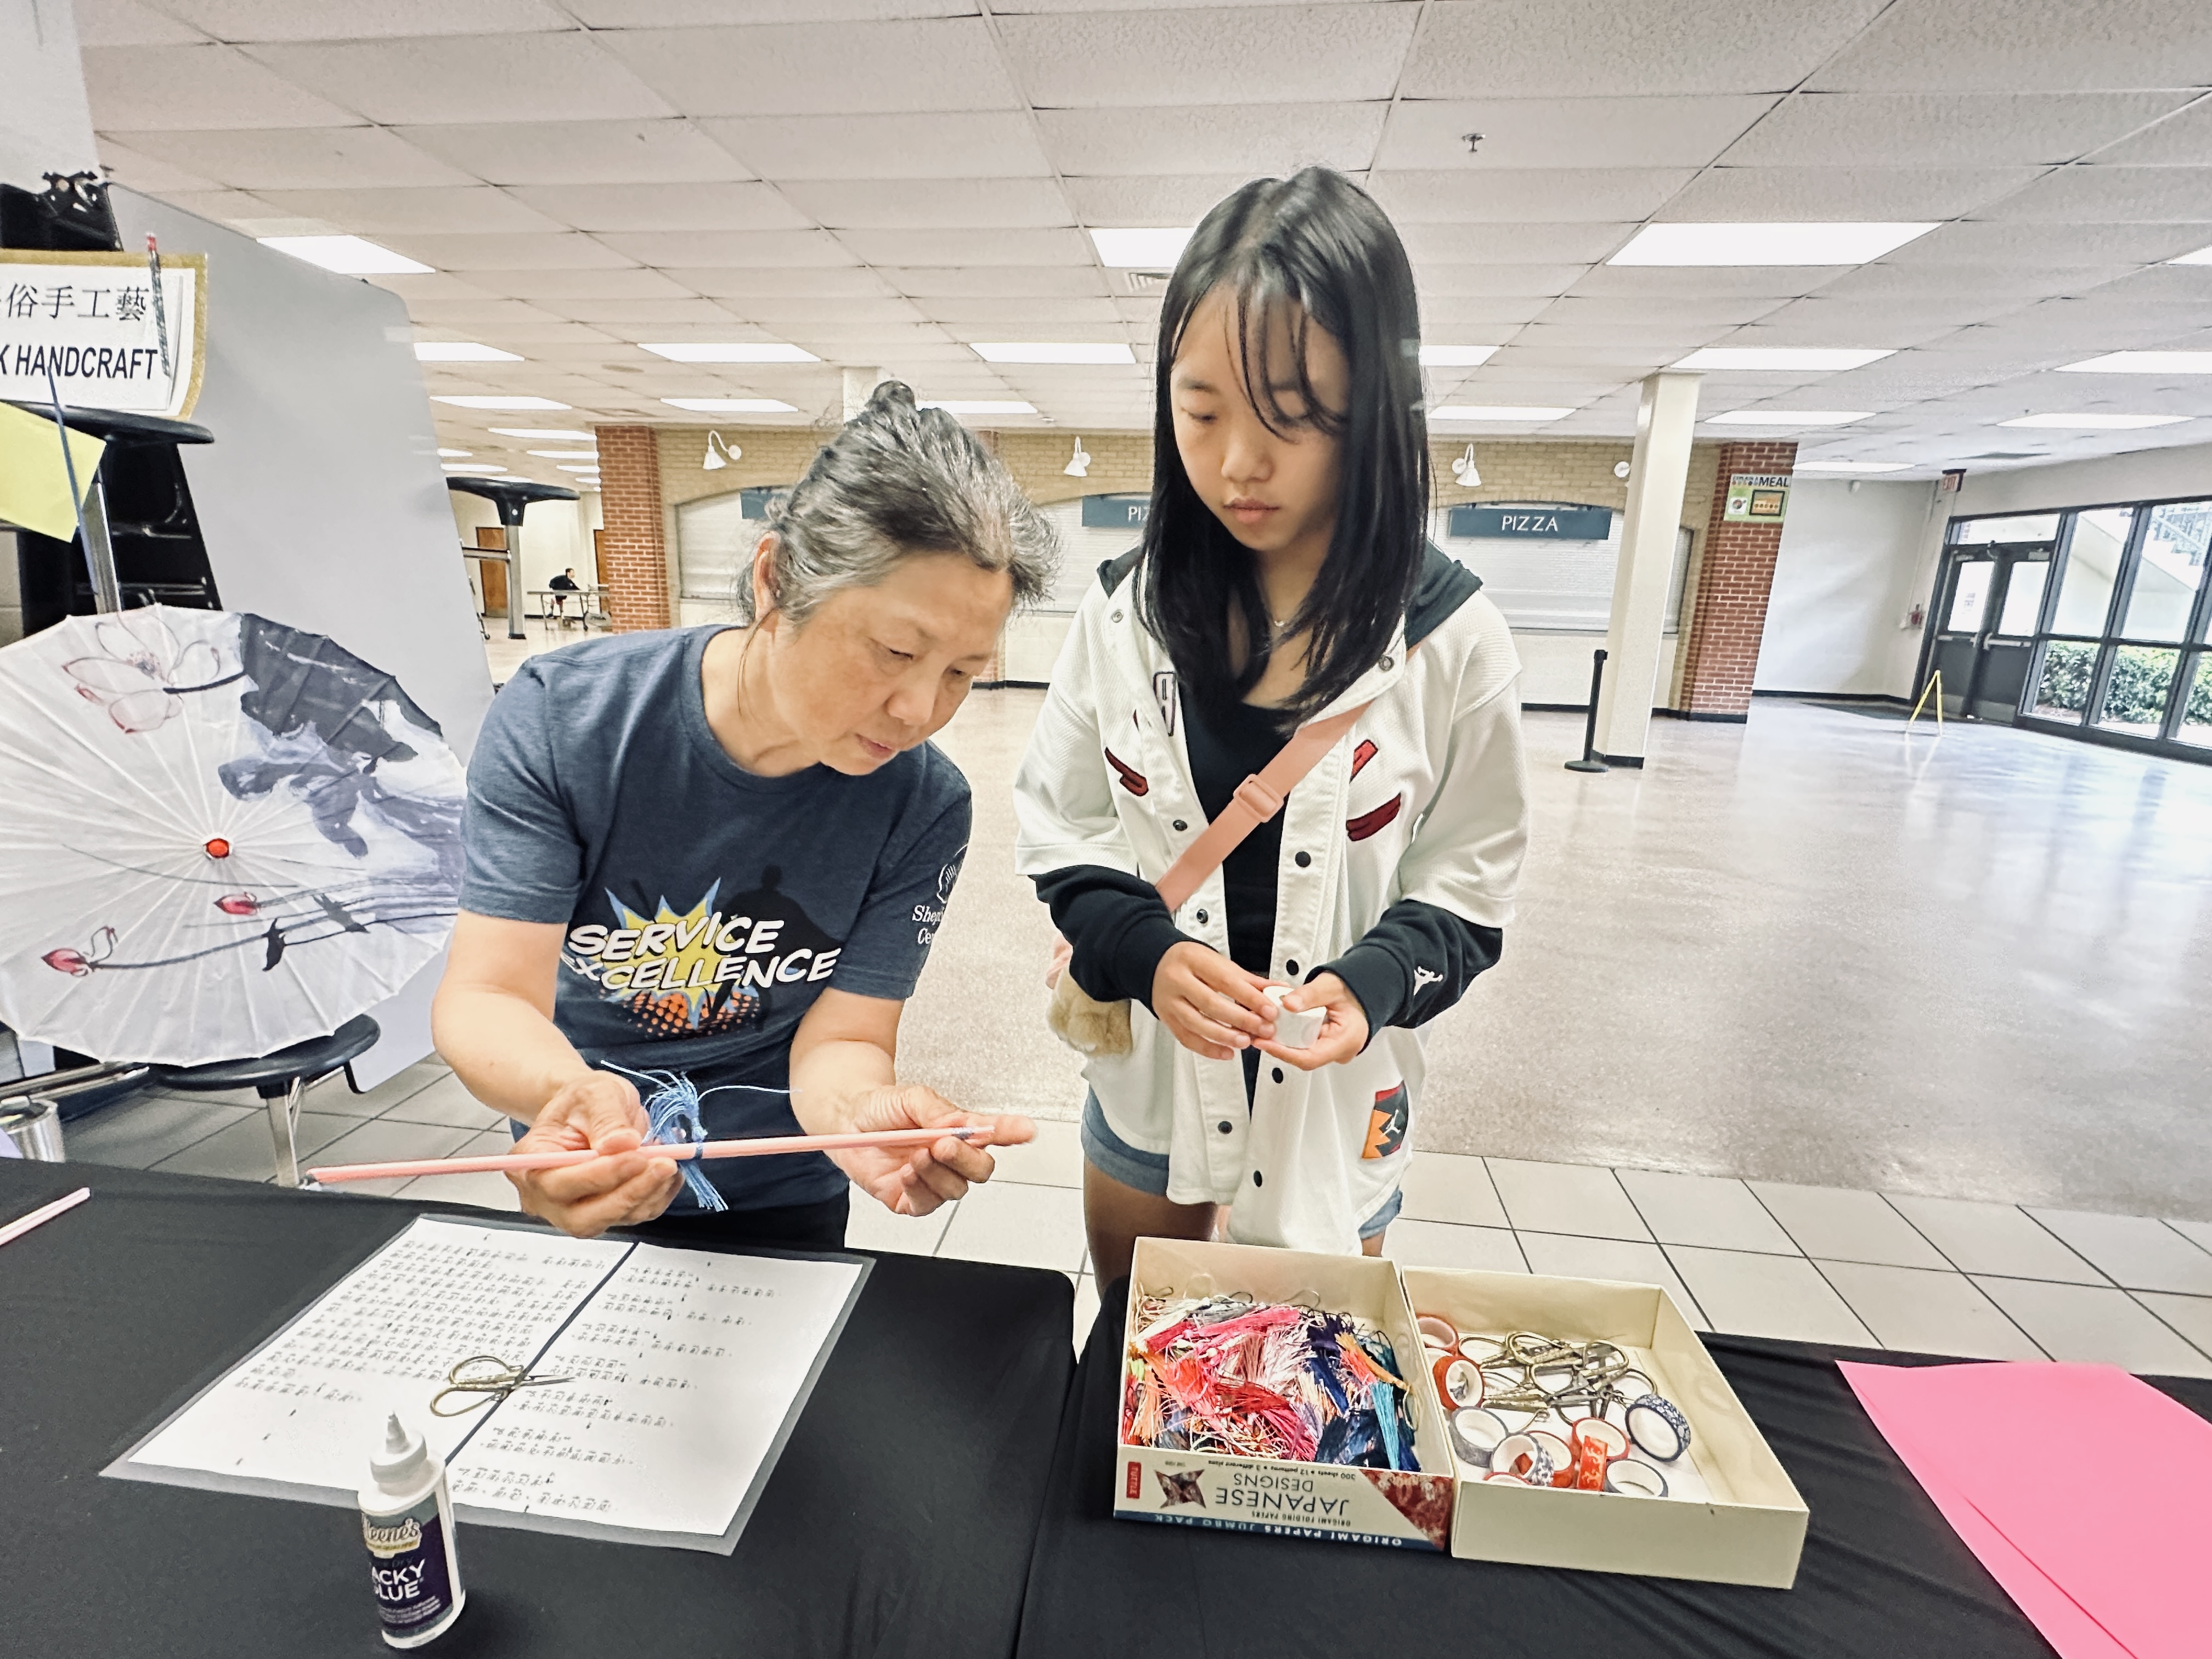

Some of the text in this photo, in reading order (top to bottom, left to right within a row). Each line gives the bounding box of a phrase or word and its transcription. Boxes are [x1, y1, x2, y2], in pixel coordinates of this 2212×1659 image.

[0, 282, 149, 321] 俗手工藝
[15, 345, 159, 380] HANDCRAFT
[1758, 476, 1789, 488] MEAL
[1501, 515, 1559, 532] PIZZA
[568, 911, 785, 962] SERVICE
[1233, 1473, 1313, 1492] DESIGNS
[1340, 1472, 1356, 1481] 300
[1215, 1487, 1350, 1516] JAPANESE
[1154, 1514, 1402, 1546] ORIGAMI PAPERS JUMBO PACK
[1251, 1510, 1351, 1527] ORIGAMI FOLDING PAPERS
[370, 1559, 425, 1585] ACKY
